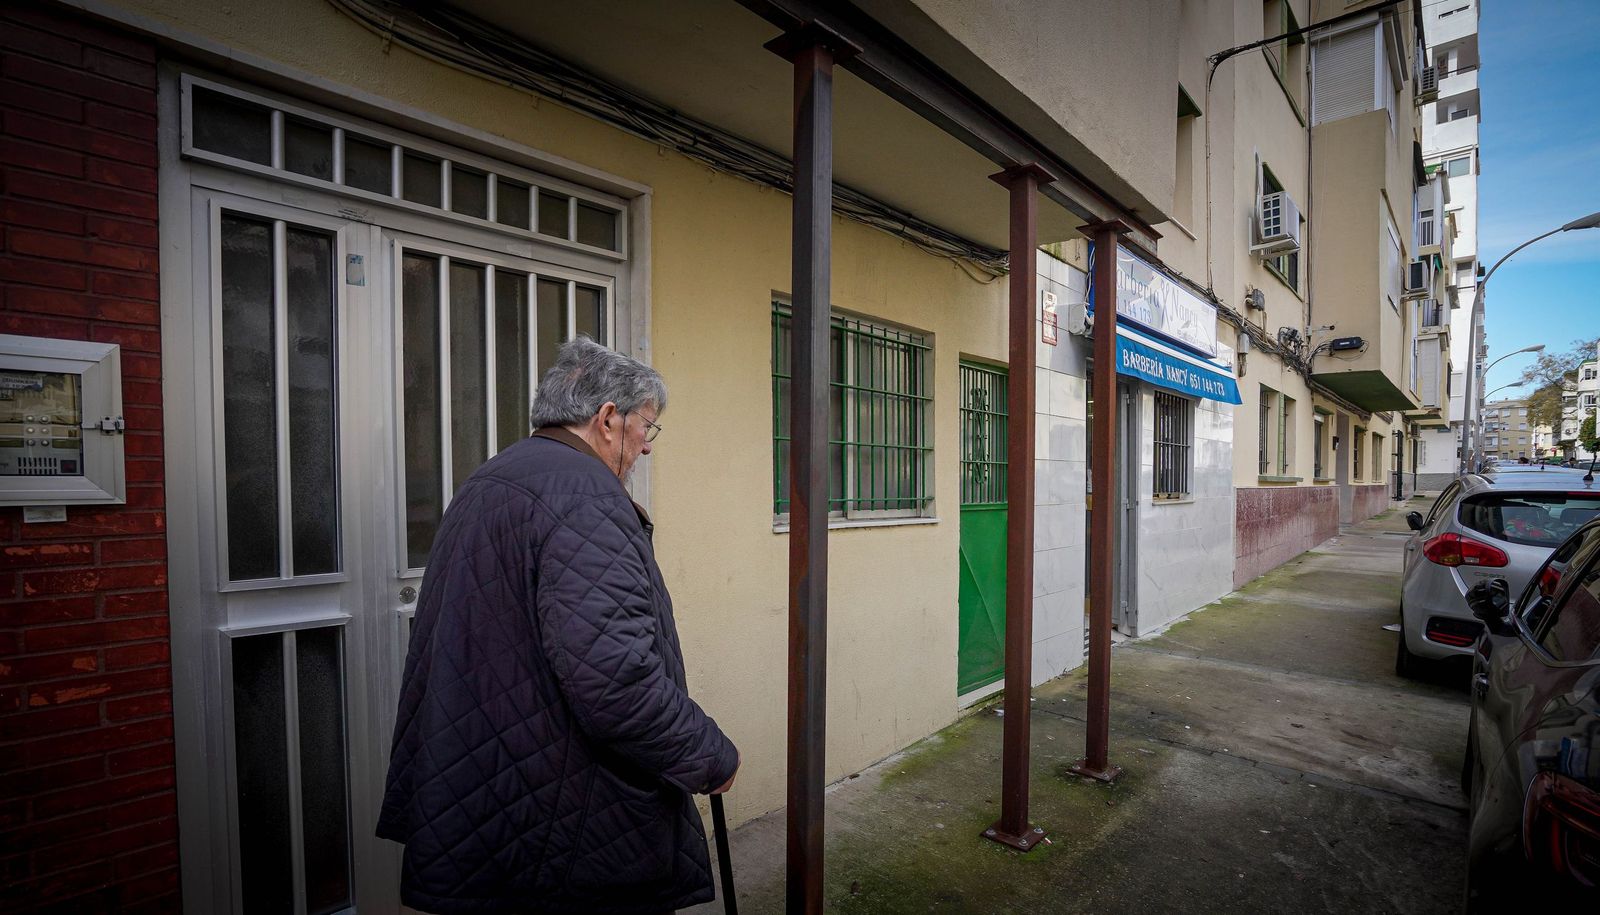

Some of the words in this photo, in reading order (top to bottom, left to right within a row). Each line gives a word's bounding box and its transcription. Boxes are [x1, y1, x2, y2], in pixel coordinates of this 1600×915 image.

[1116, 263, 1160, 309] arbería
[1122, 348, 1164, 379] BARBERÍA
[1166, 364, 1188, 386] NANCY
[1189, 373, 1201, 390] 651
